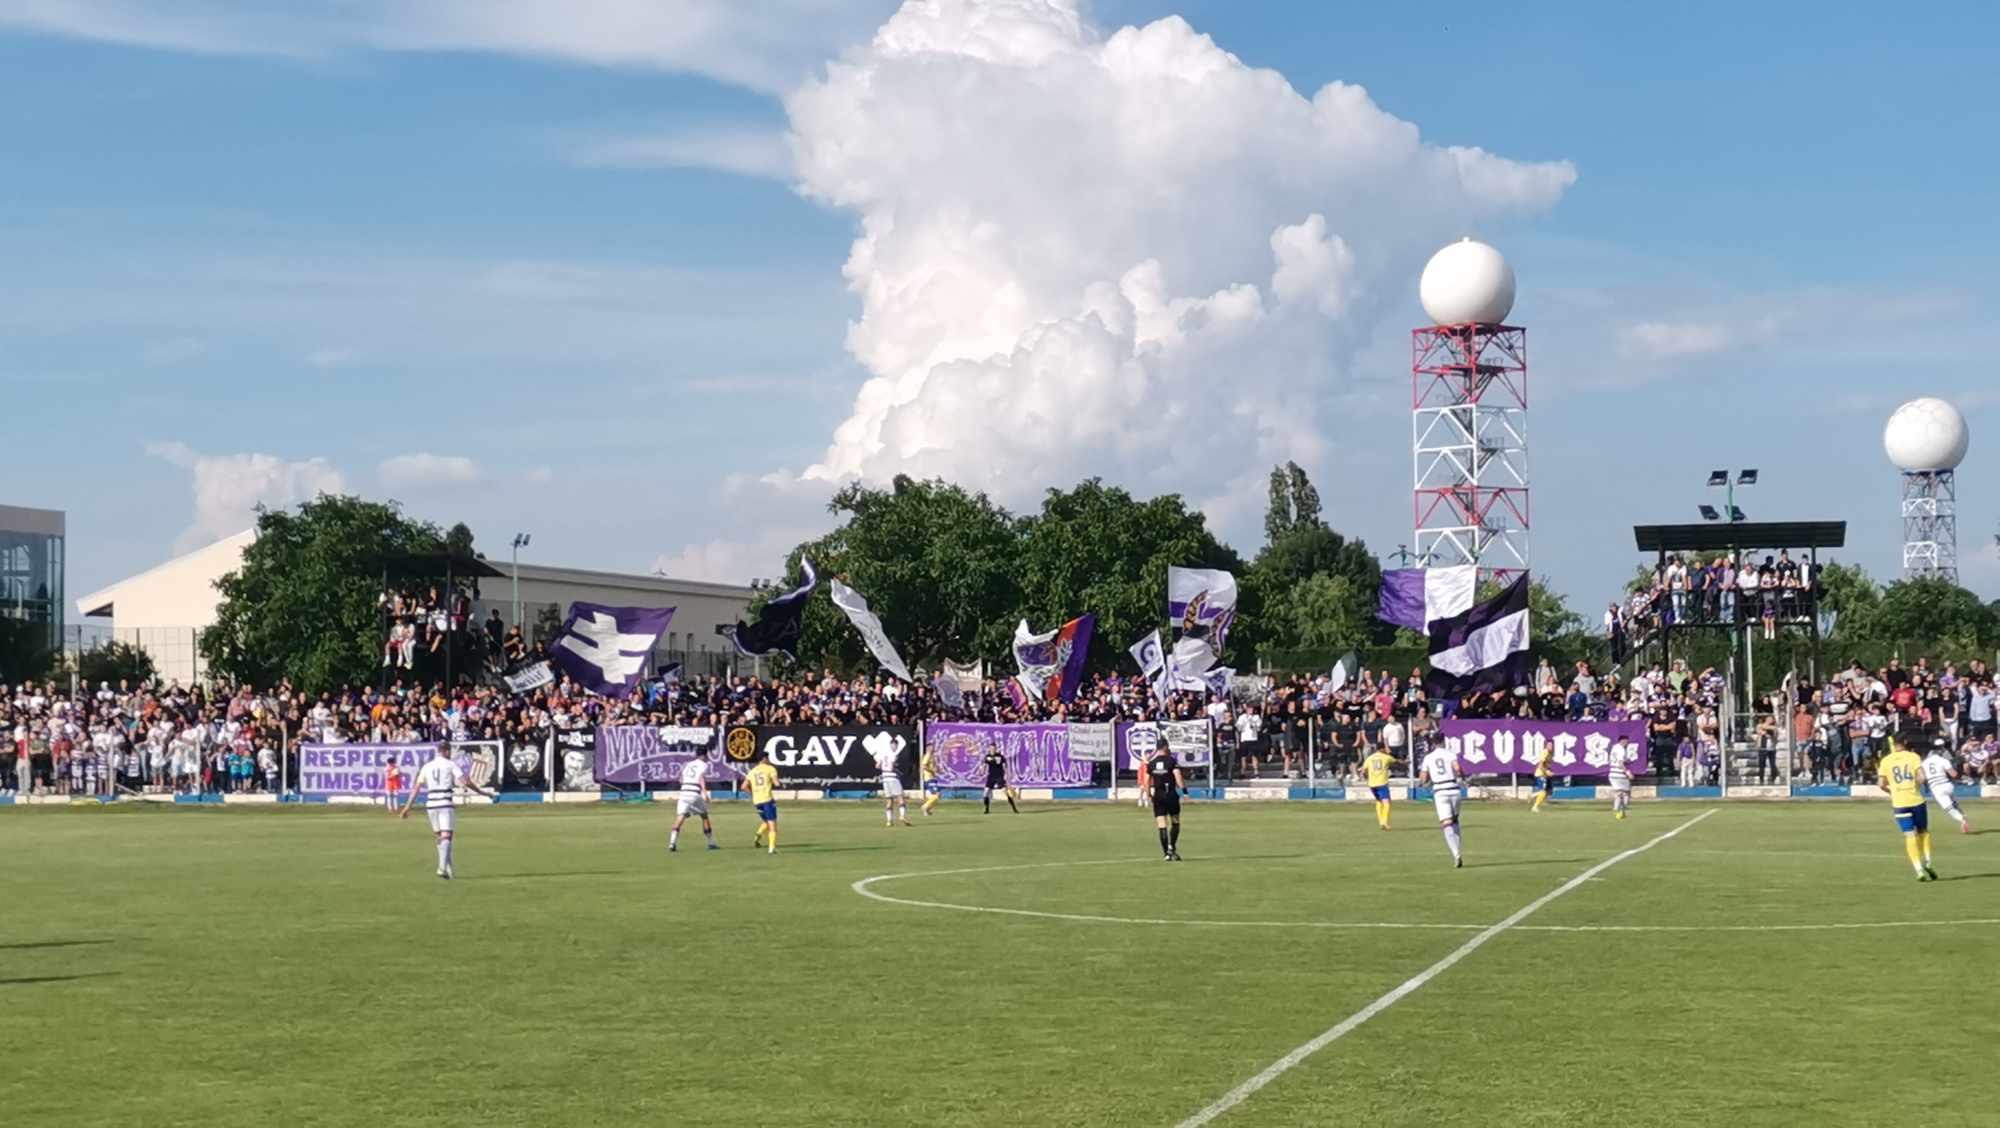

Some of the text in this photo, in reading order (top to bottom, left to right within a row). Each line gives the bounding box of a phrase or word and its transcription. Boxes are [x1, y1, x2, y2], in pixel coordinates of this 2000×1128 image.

[764, 736, 857, 767] GAV
[432, 767, 441, 785] 4
[1434, 758, 1447, 776] 9
[1891, 764, 1914, 784] 84
